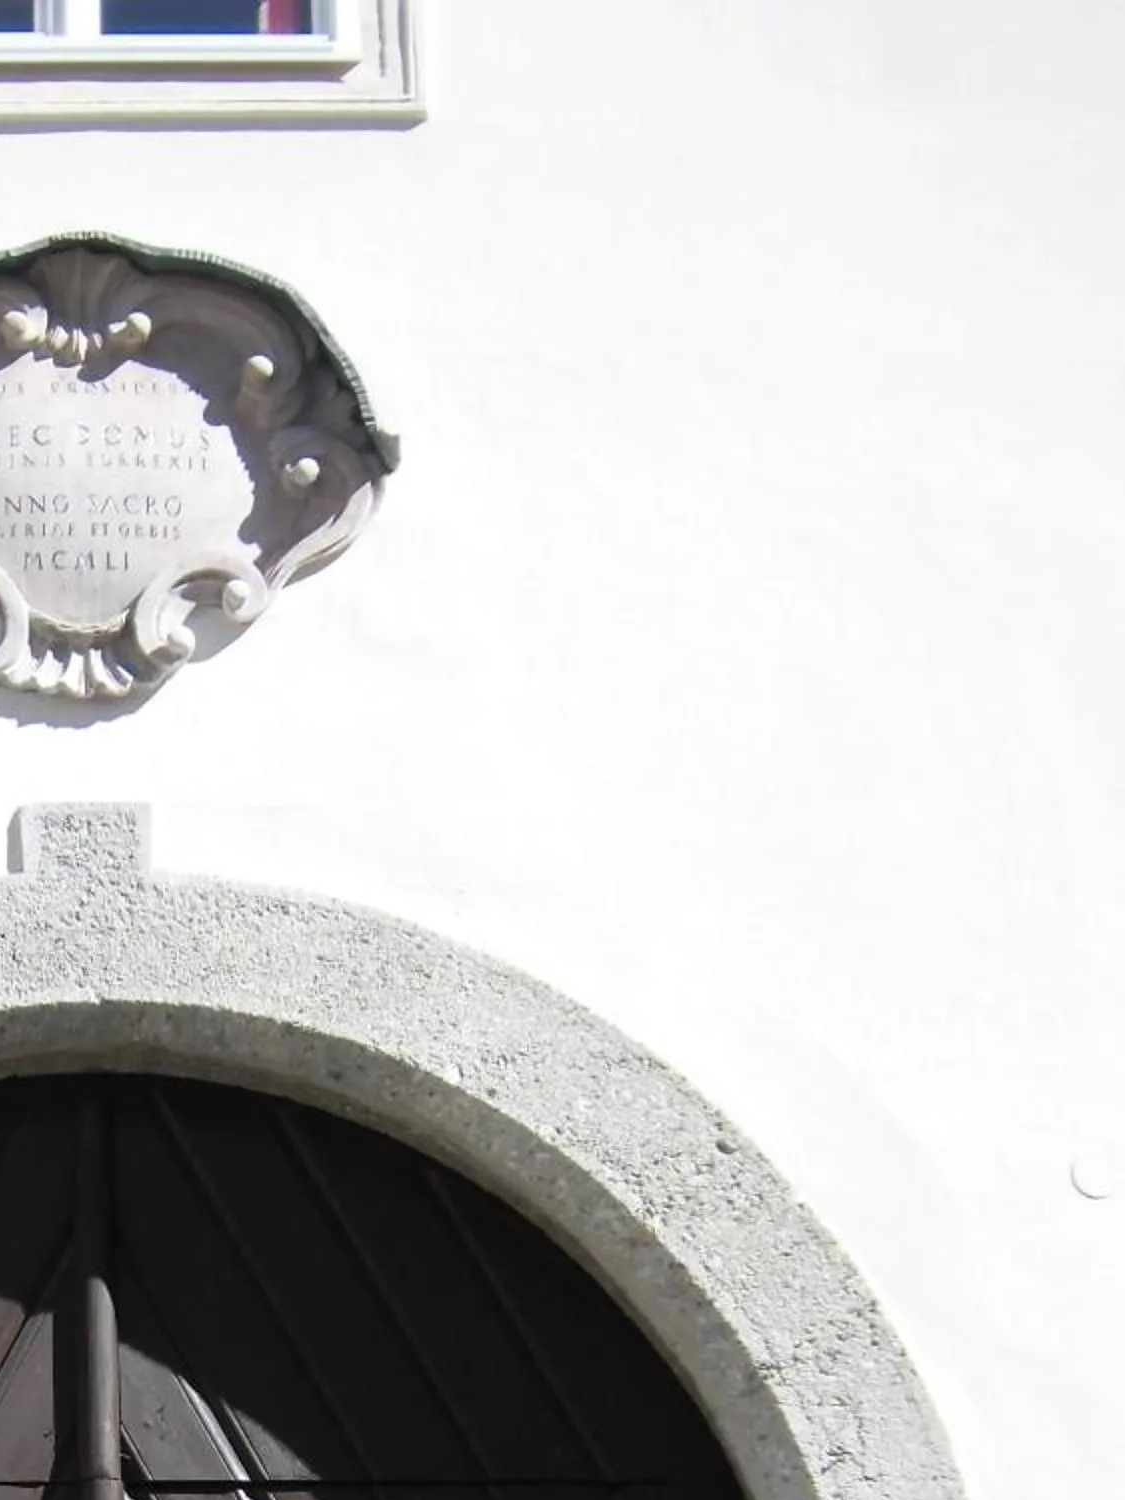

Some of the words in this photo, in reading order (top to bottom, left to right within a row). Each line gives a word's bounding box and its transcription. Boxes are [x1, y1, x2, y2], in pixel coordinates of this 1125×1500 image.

[76, 423, 212, 453] DOMUS
[87, 494, 184, 517] SACRO
[22, 549, 132, 574] MCMLI
